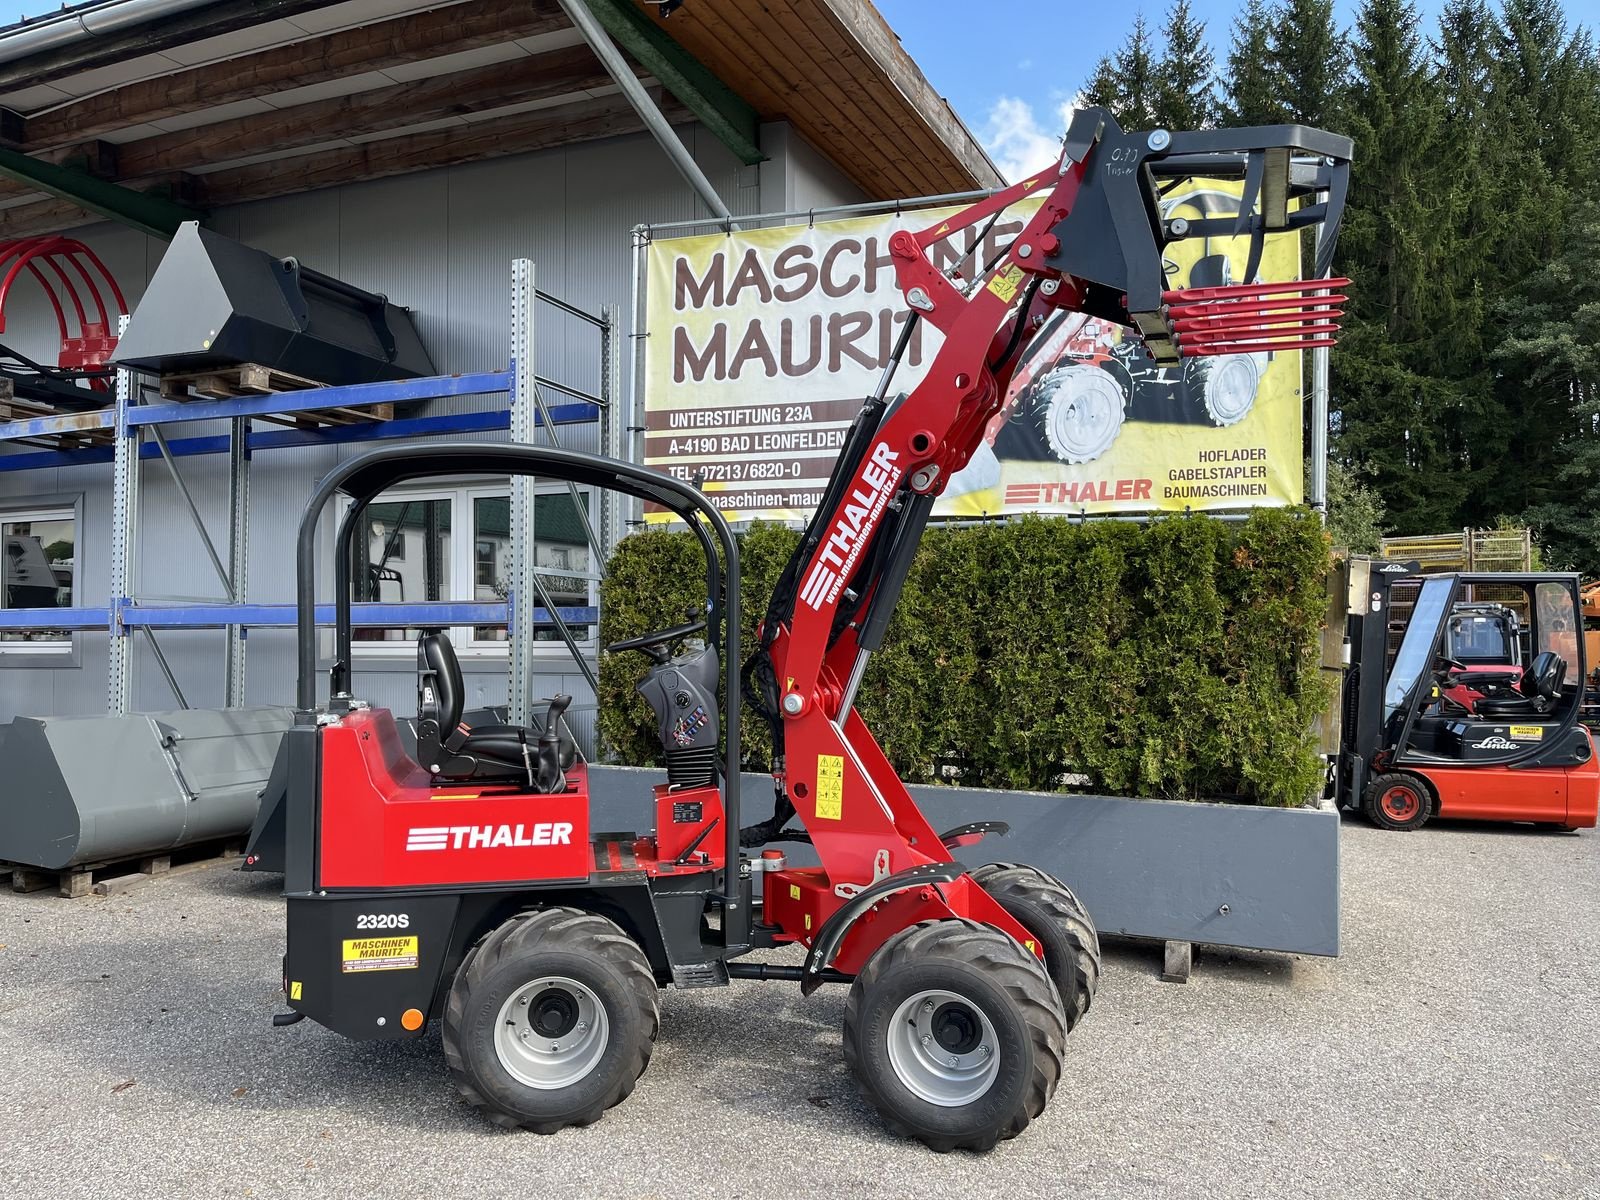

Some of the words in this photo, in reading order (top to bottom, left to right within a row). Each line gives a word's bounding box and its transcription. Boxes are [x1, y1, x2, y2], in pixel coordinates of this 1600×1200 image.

[669, 408, 781, 427] UNTERSTIFTUNG
[785, 405, 813, 422] 23A
[668, 438, 718, 454] A-4190
[721, 436, 750, 451] BAD
[754, 430, 846, 449] LEONFELDEN
[1199, 448, 1267, 463] HOFLADER
[1168, 466, 1267, 481] GABELSTAPLER
[1040, 479, 1153, 504] THALER
[1163, 483, 1267, 499] BAUMASCHINEN
[819, 441, 899, 568] THALER
[826, 466, 902, 604] www.maschinen-mauritz.at
[1471, 736, 1520, 750] Linde
[449, 822, 573, 849] THALER
[356, 913, 410, 929] 2320S
[352, 938, 411, 950] MASCHINEN
[359, 947, 404, 958] MAURITZ
